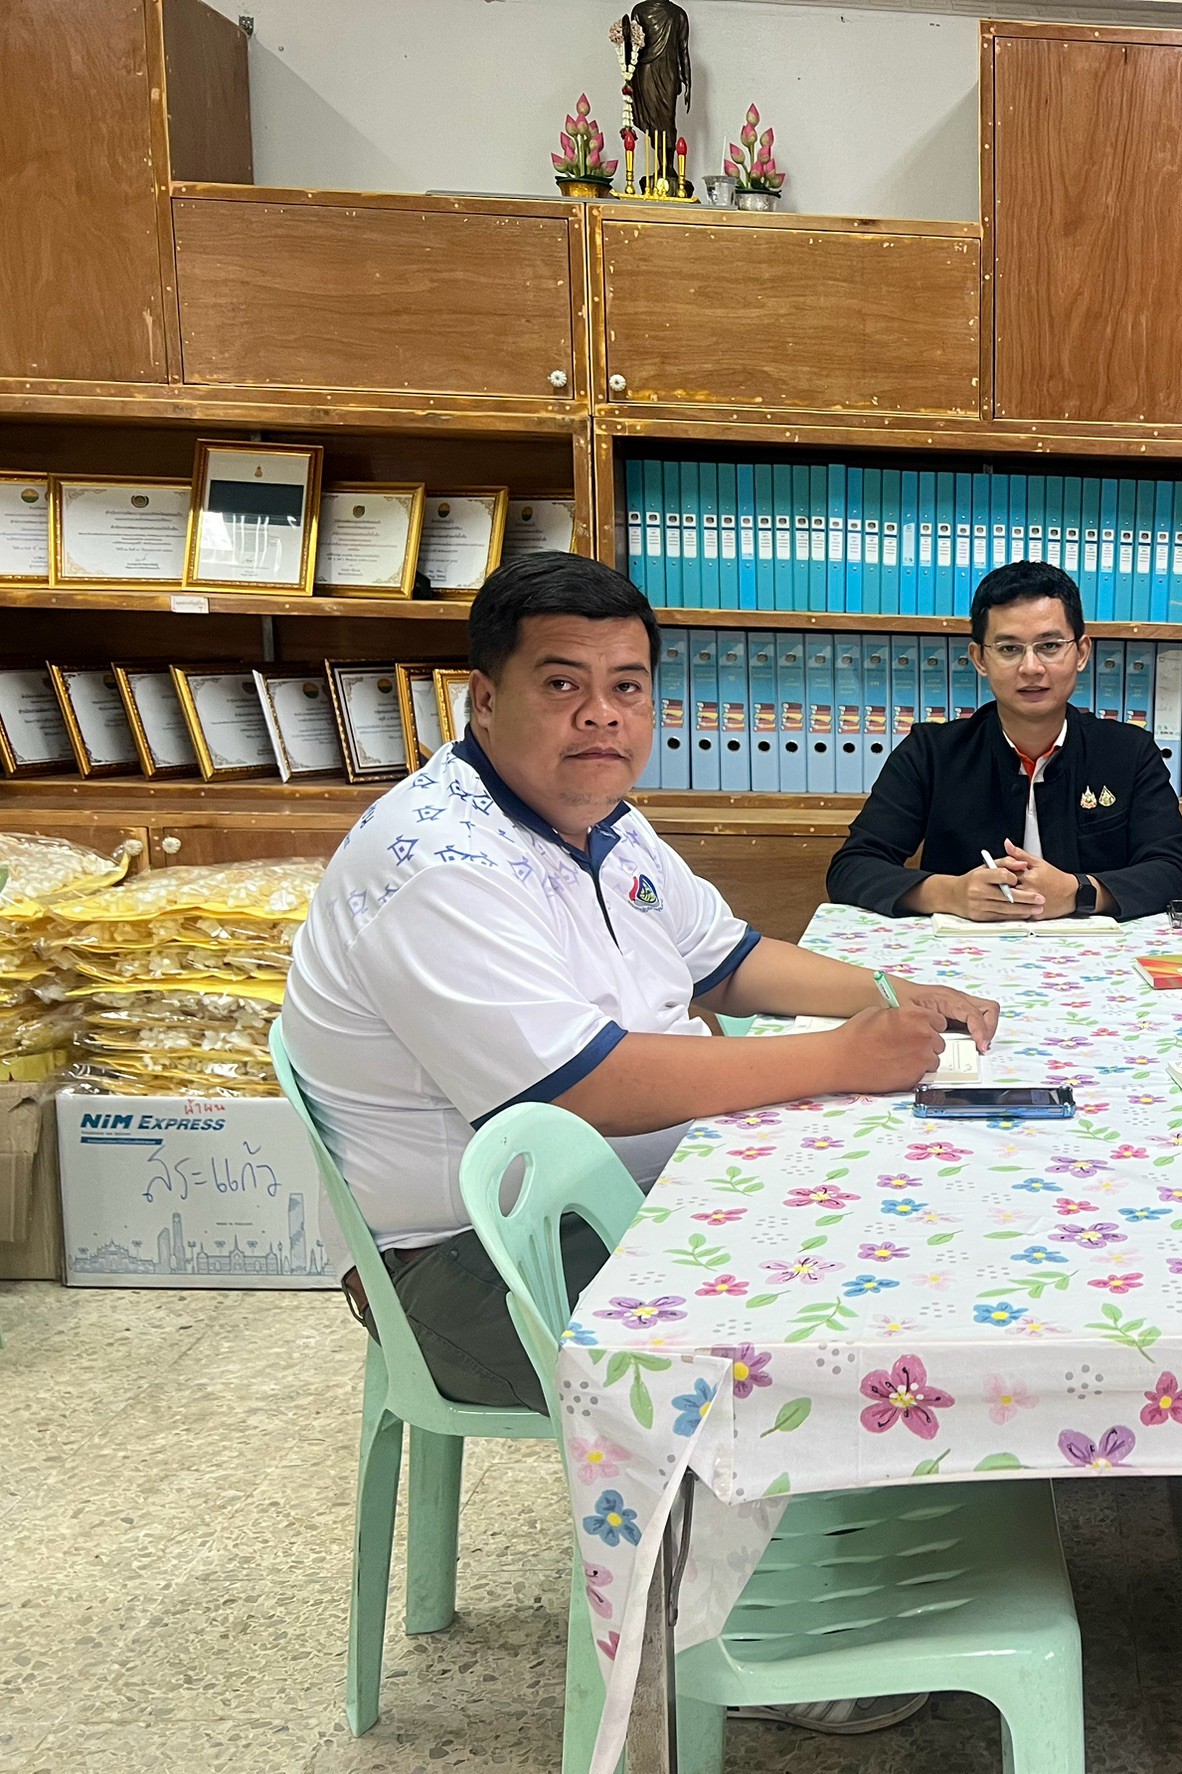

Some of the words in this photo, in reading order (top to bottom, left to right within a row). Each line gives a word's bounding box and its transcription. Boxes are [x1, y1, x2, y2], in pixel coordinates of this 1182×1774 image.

[137, 1115, 226, 1131] EXPRESS
[142, 1140, 282, 1203] สระแก้ว
